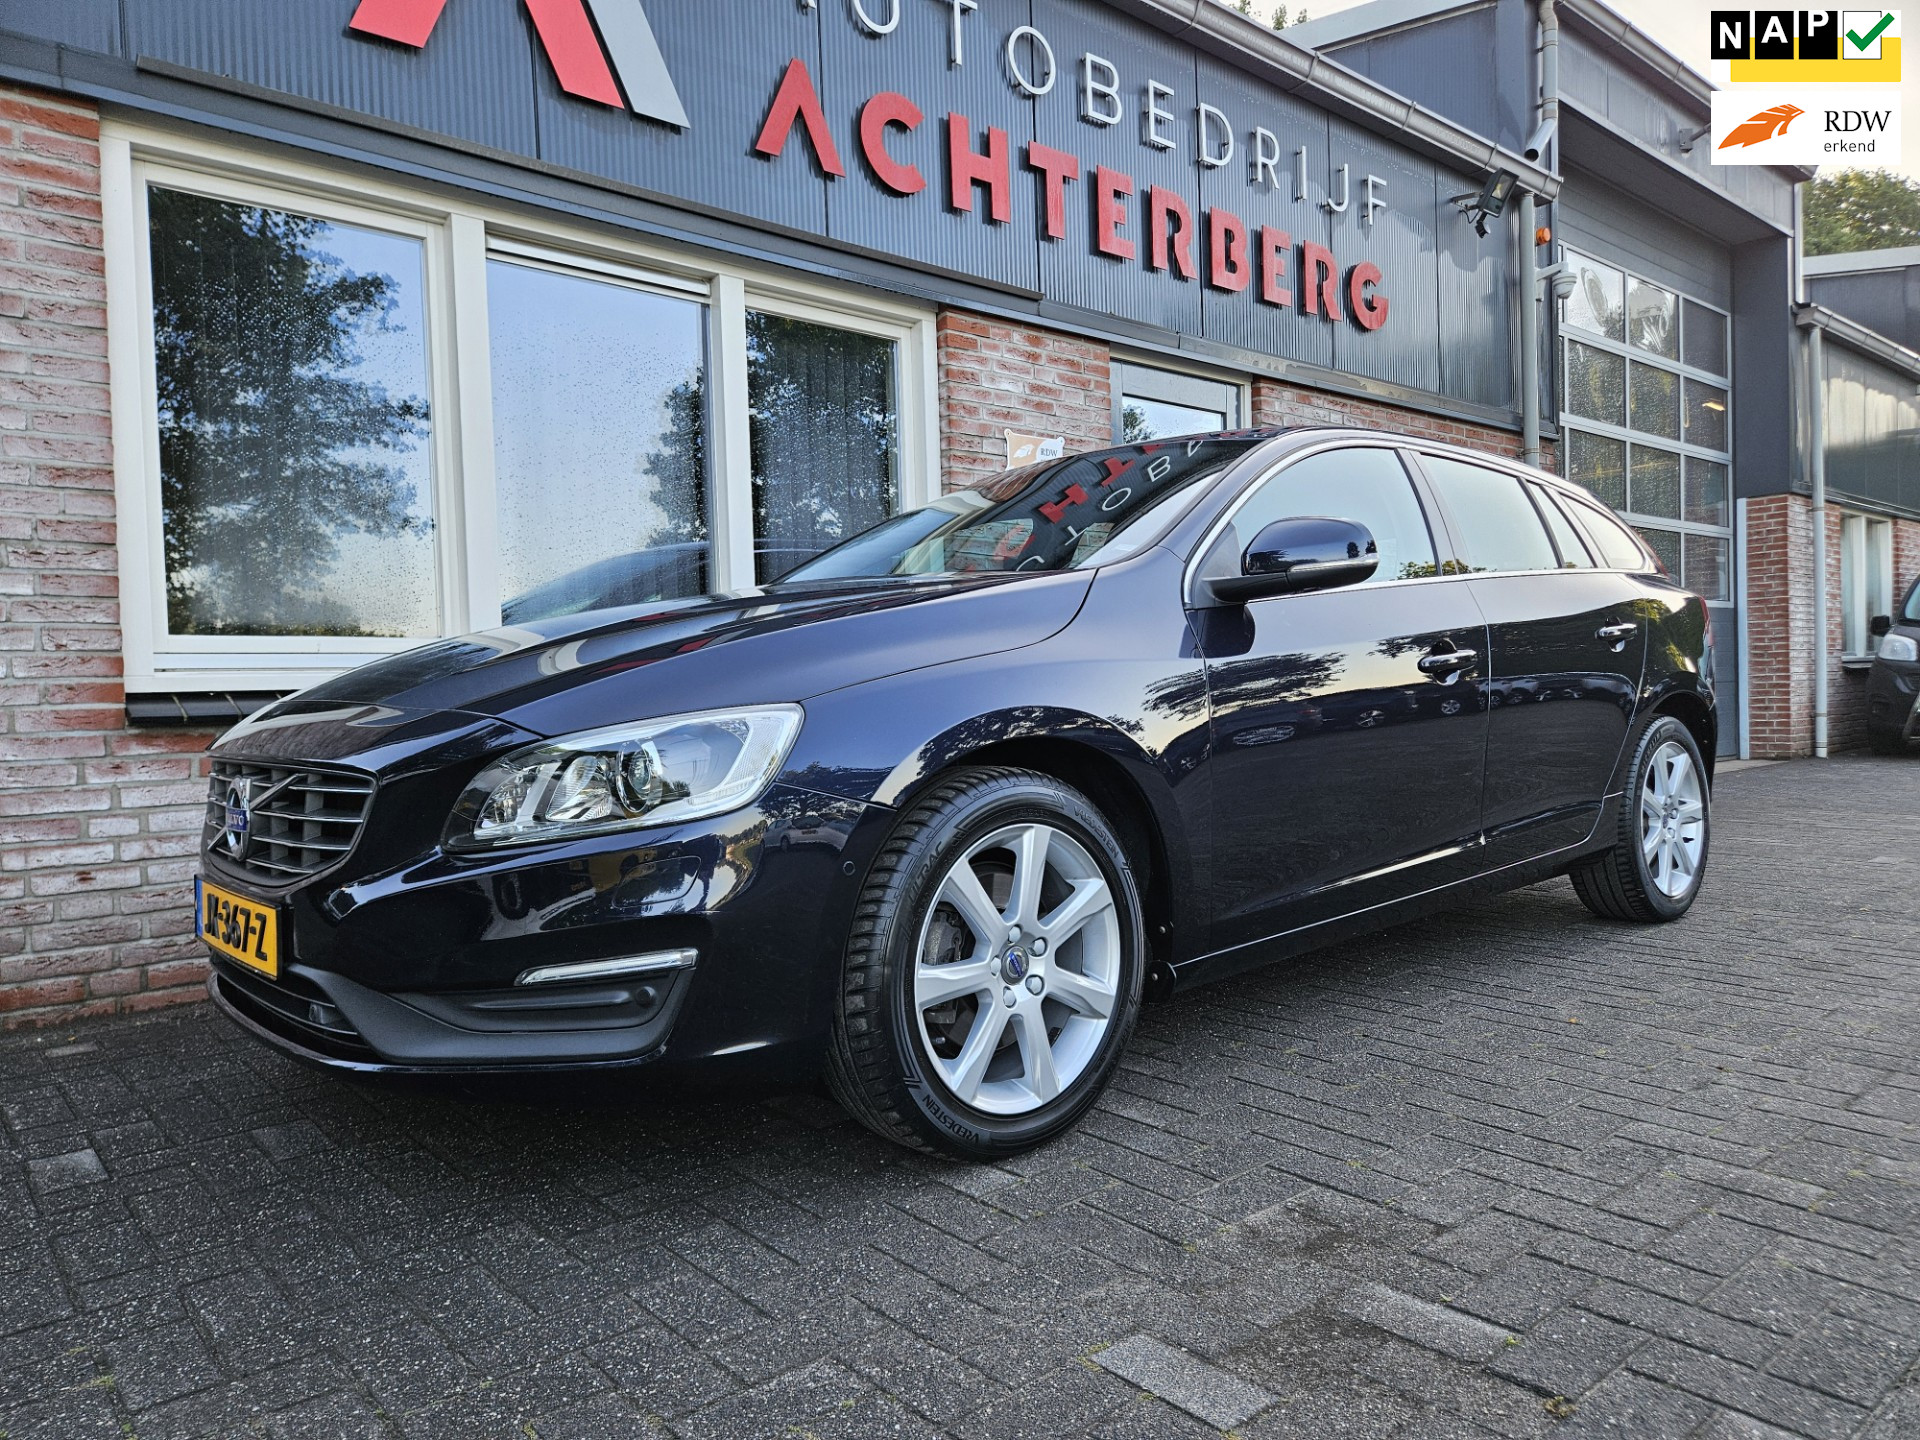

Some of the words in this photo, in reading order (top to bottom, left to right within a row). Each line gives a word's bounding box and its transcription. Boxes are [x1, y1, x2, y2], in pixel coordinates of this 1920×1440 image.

[806, 0, 1387, 226] TOBEDRIJF
[755, 57, 1390, 331] ACHTERBERG
[1040, 447, 1058, 457] RDW
[908, 840, 942, 905] ULTRAC
[922, 1094, 980, 1142] VREDESTEIN
